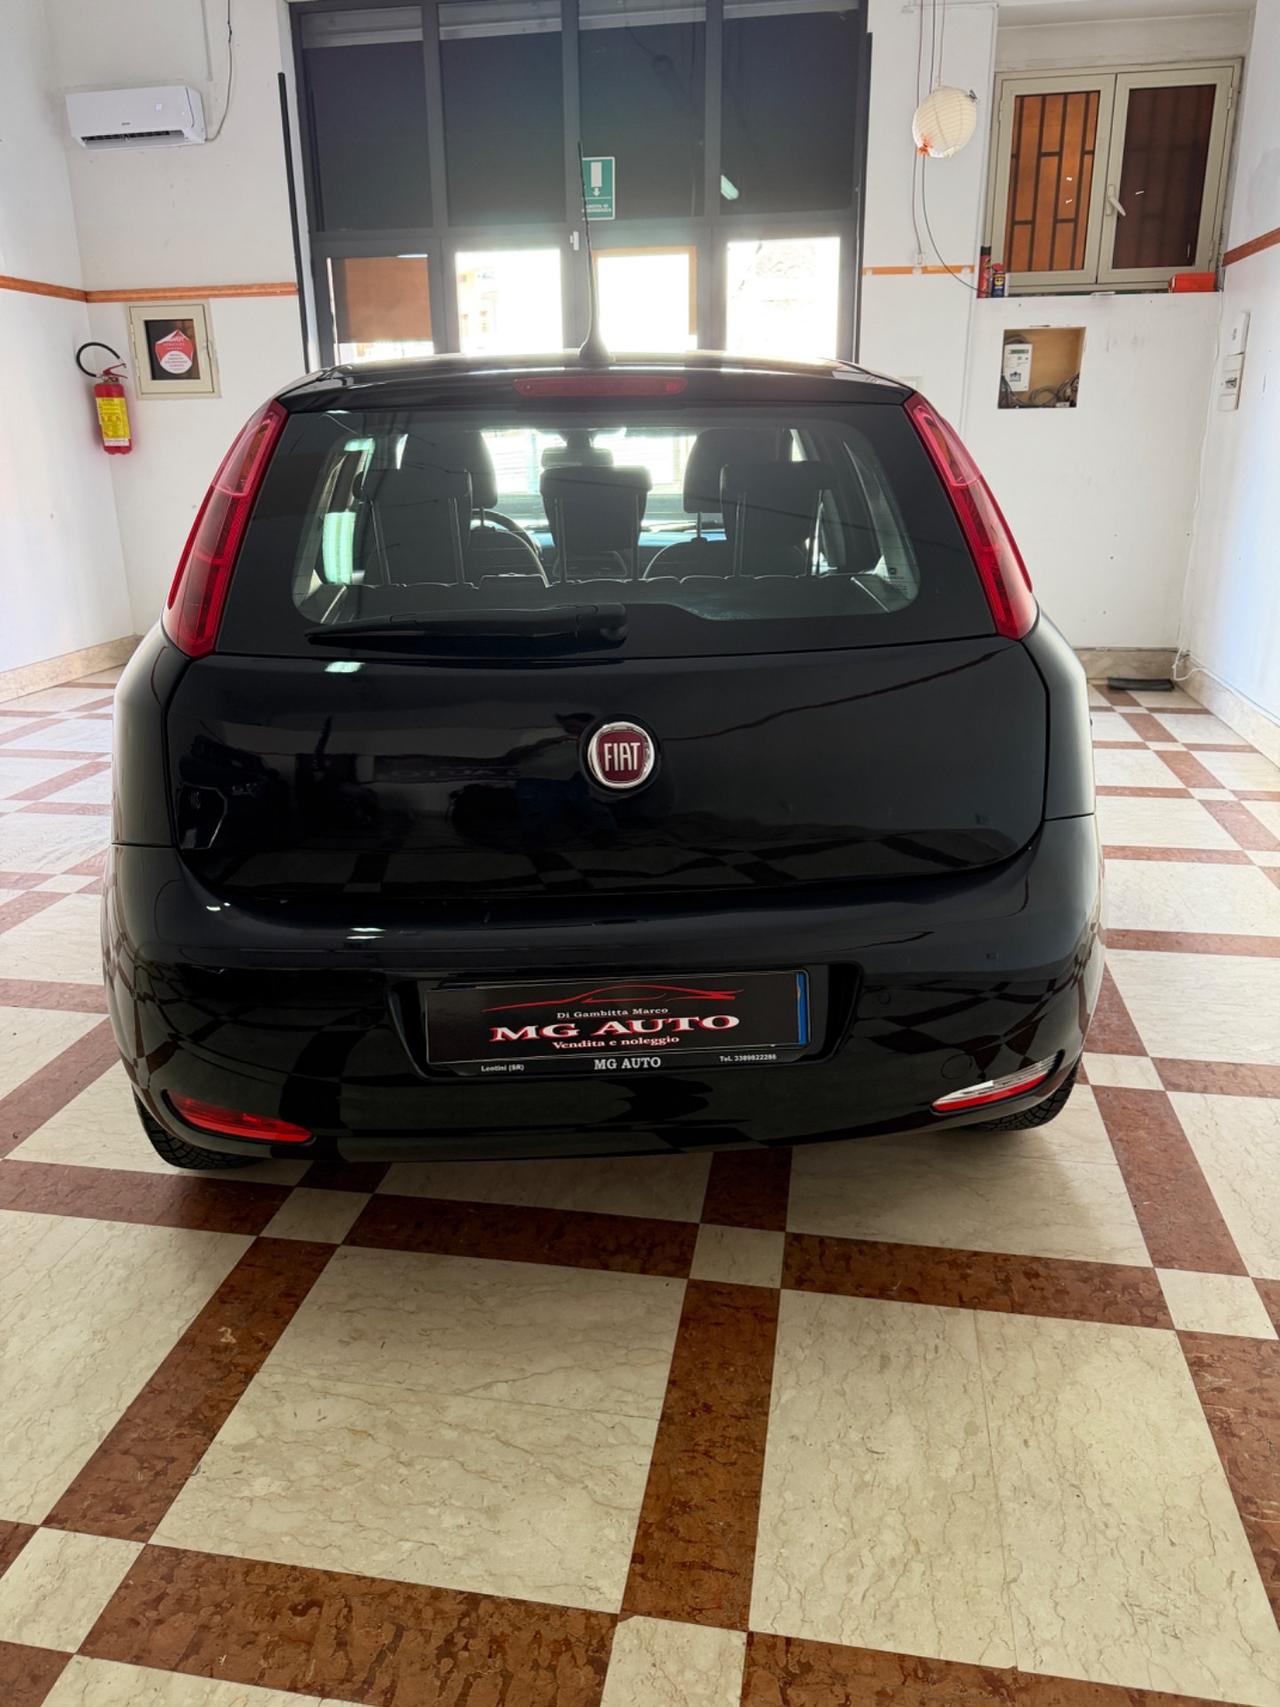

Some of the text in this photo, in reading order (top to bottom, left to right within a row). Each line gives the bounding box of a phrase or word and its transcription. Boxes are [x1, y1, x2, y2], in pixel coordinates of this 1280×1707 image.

[603, 742, 641, 772] FIAT
[557, 1007, 669, 1019] Di Gambitta Marco
[489, 1014, 740, 1042] MG AUTO
[552, 1039, 606, 1049] Vendita
[621, 1035, 680, 1046] noleggio
[594, 1056, 662, 1070] MG AUTO
